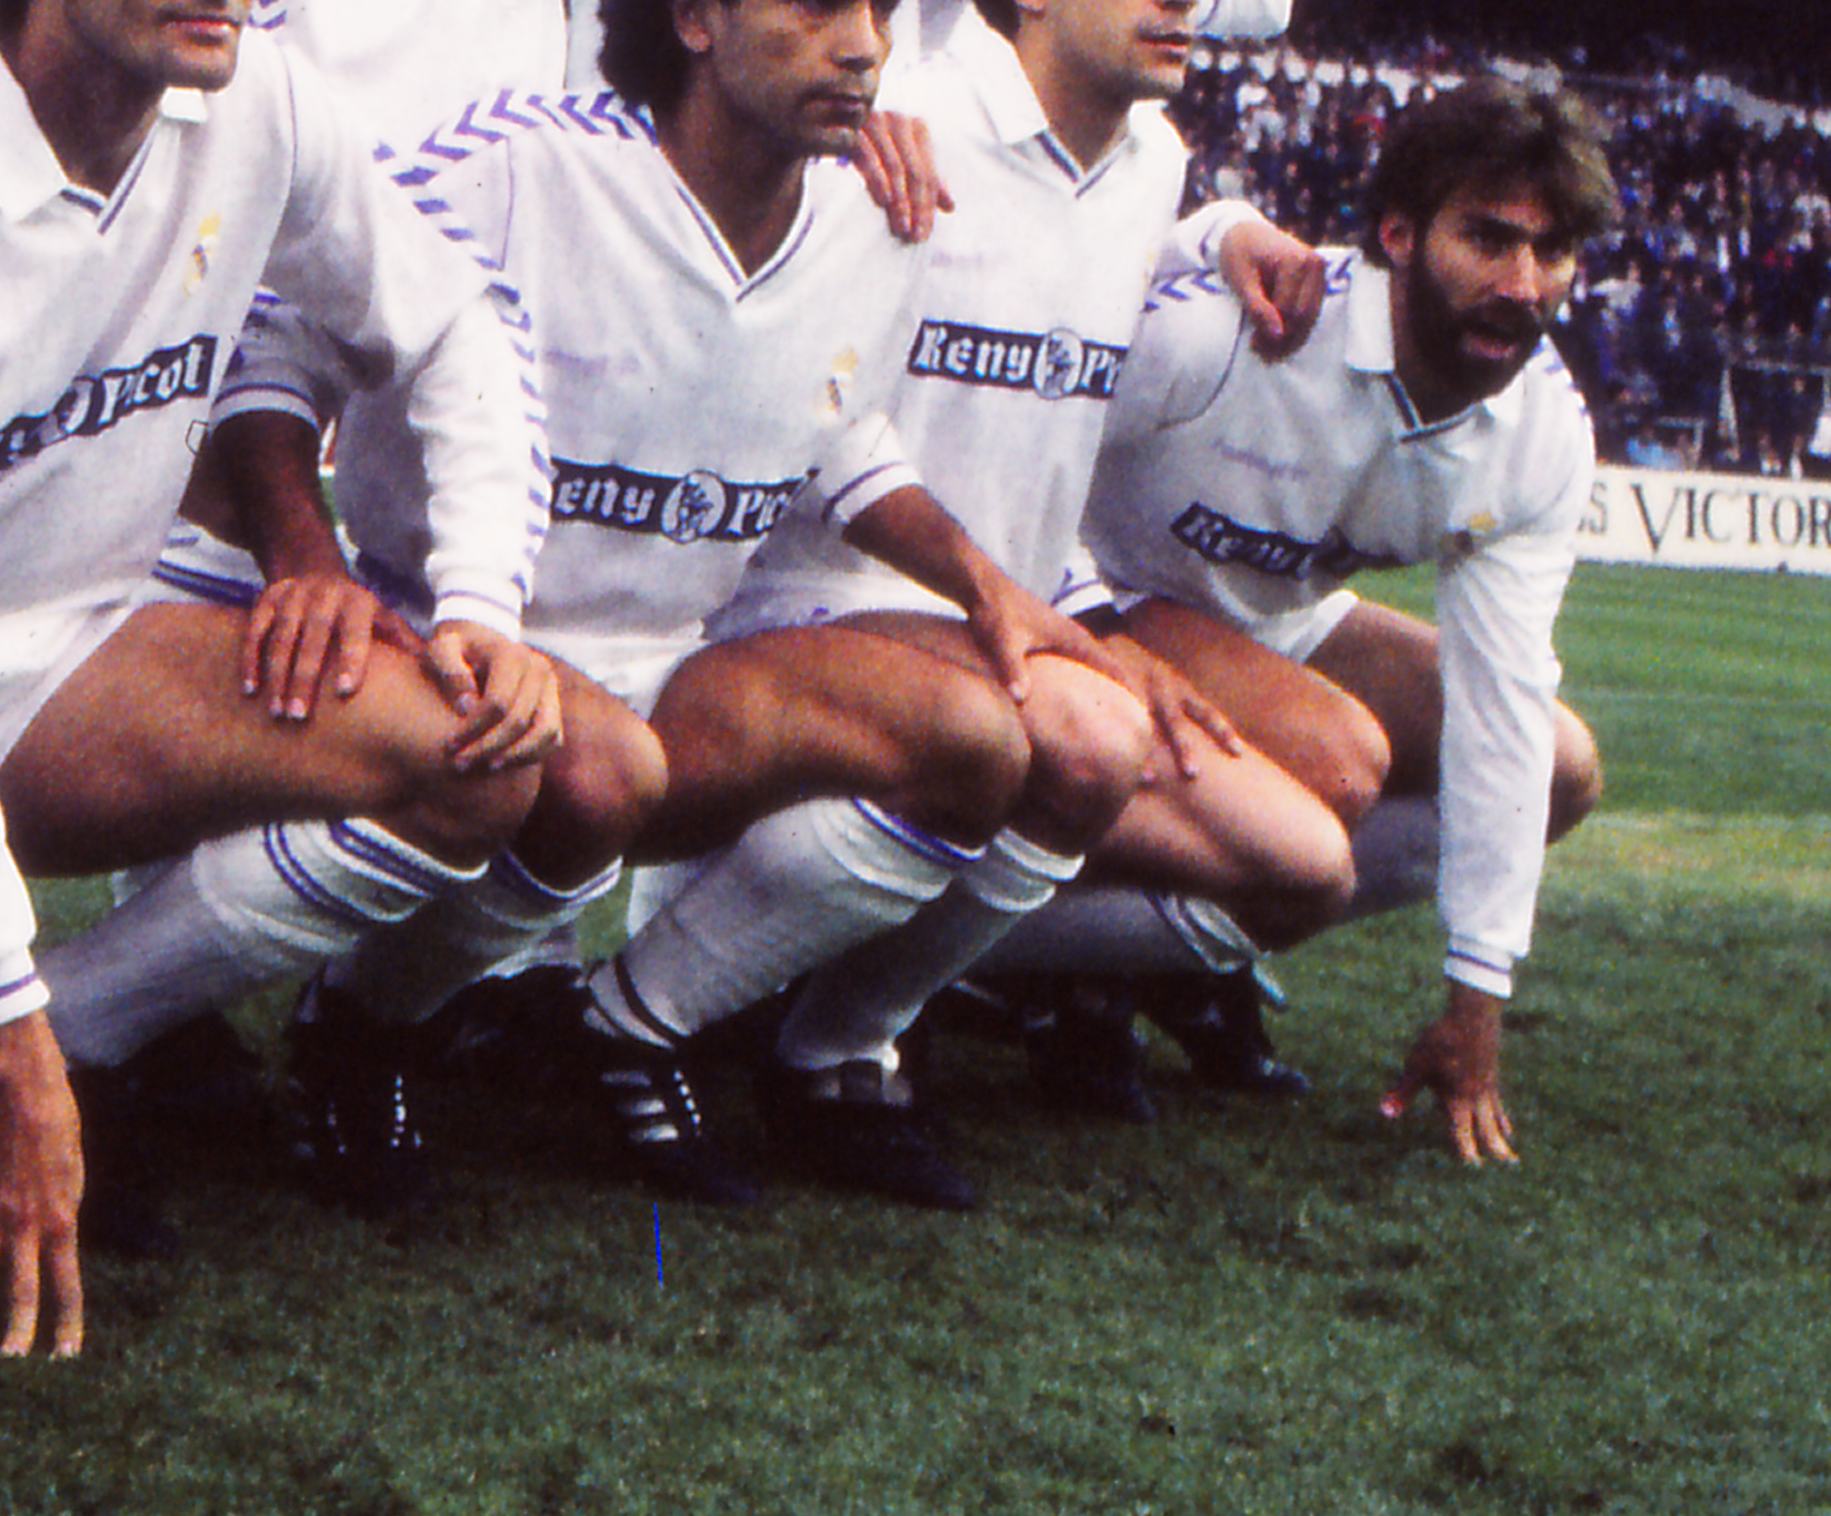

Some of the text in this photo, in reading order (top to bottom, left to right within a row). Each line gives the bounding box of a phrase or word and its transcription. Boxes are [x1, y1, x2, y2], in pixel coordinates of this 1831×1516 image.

[912, 324, 1034, 383] Reny
[554, 477, 656, 525] eny
[1630, 484, 1831, 553] VICTOR
